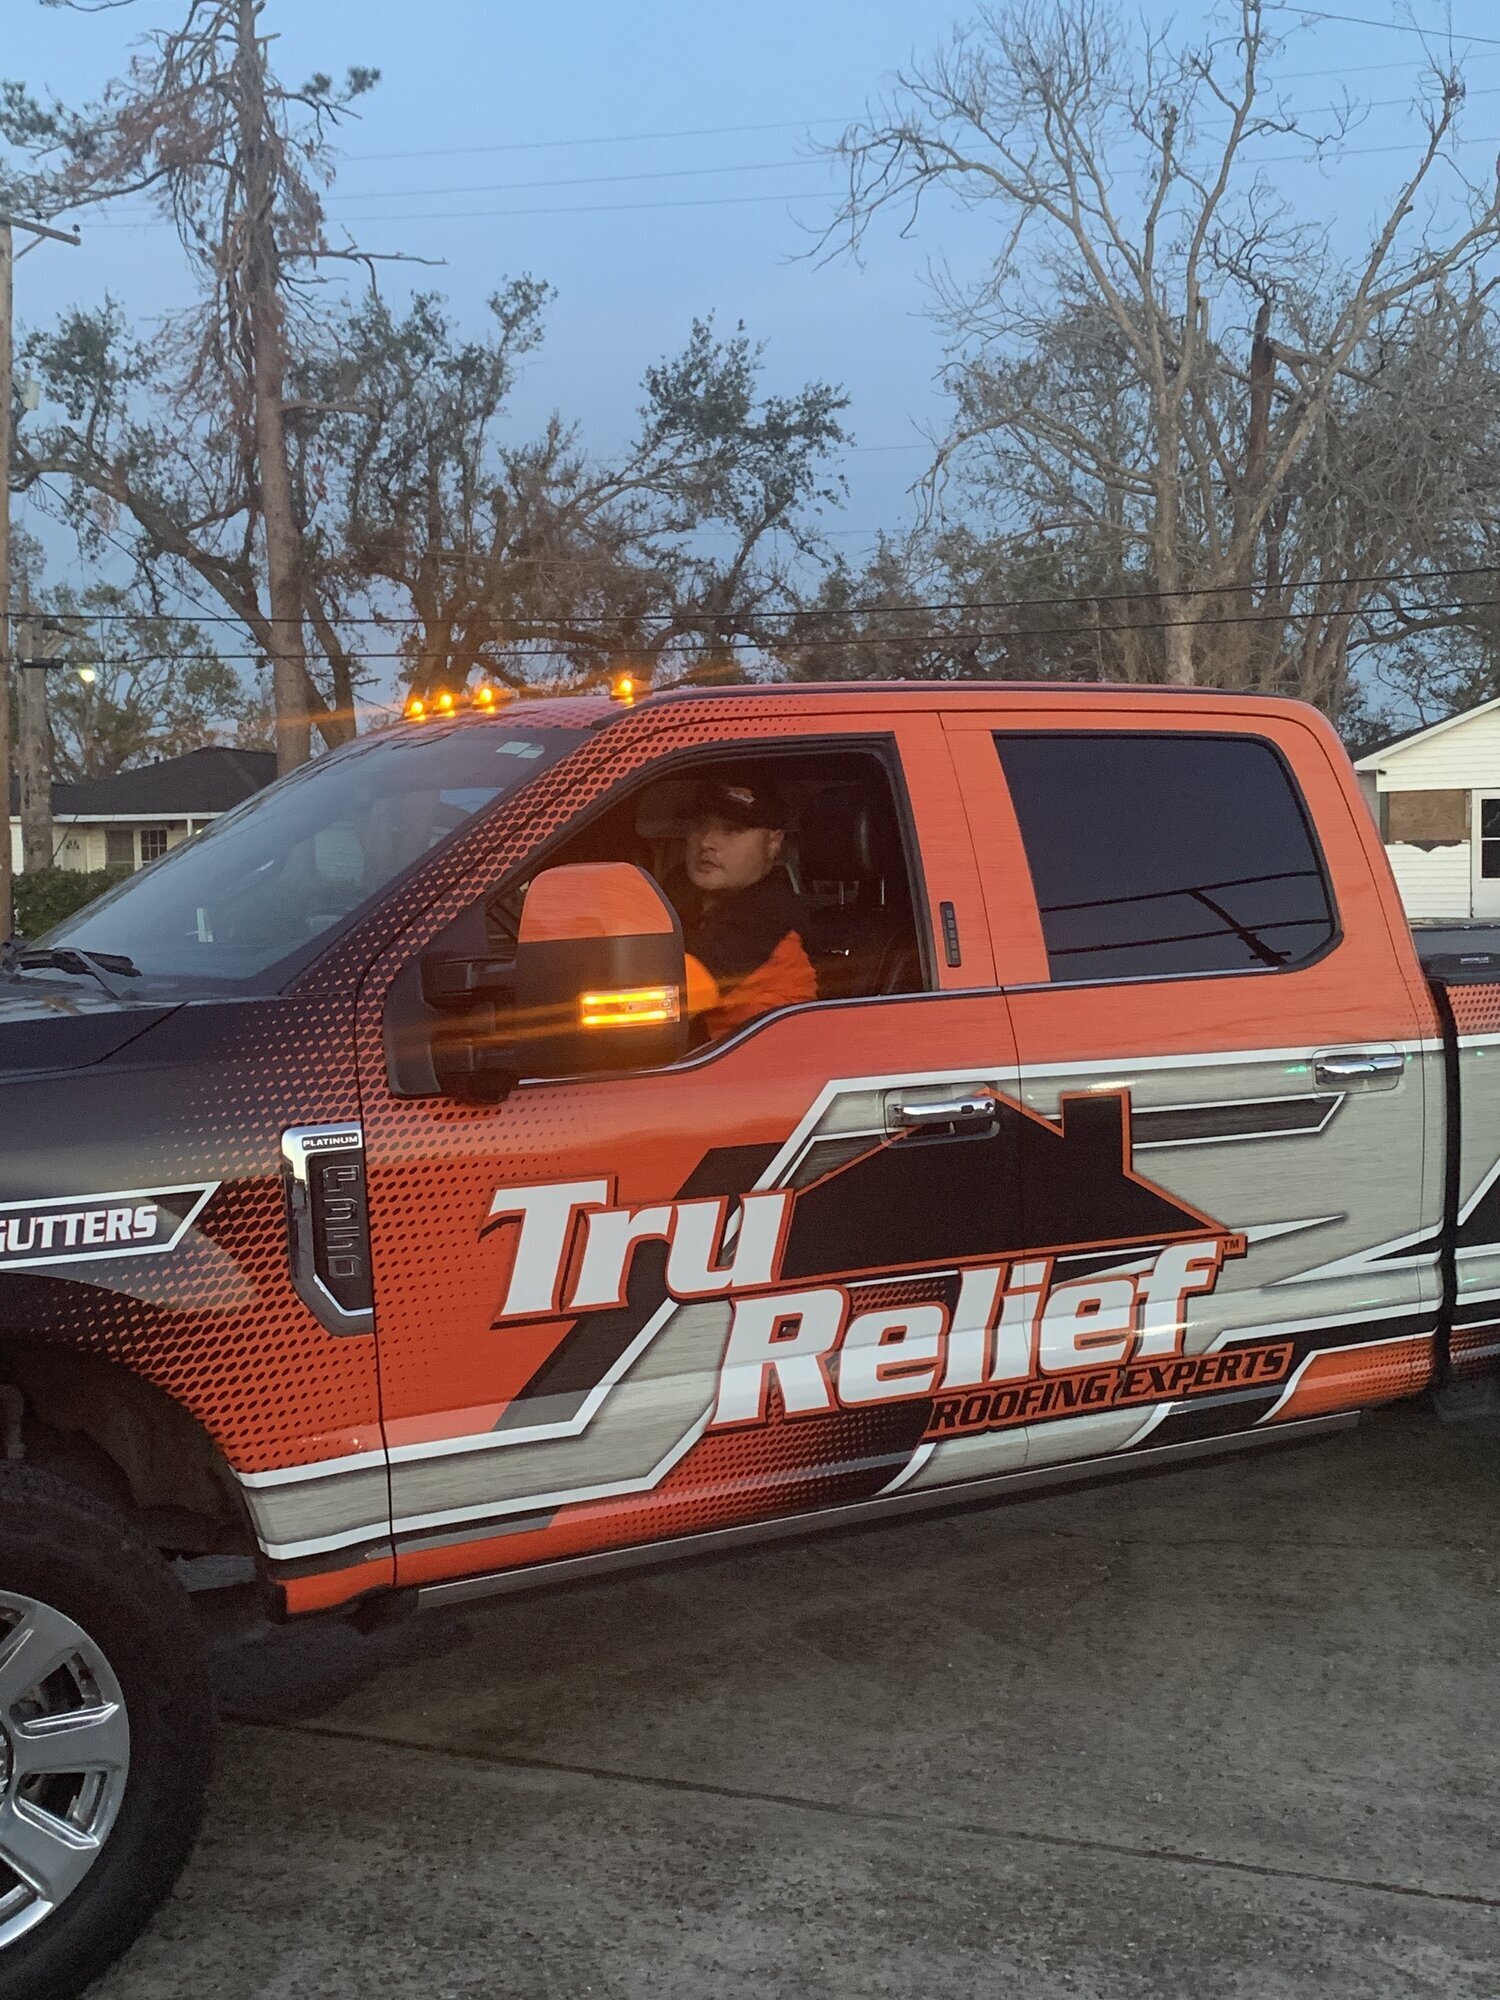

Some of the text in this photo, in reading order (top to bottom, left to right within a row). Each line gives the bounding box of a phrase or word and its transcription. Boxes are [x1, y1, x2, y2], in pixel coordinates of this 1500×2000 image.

[303, 1135, 358, 1147] PLATINUM
[0, 1205, 158, 1252] UTTERS
[487, 1178, 788, 1317] Tru
[711, 1240, 1218, 1426] Relief
[926, 1345, 1289, 1431] ROOFING EXPERTS
